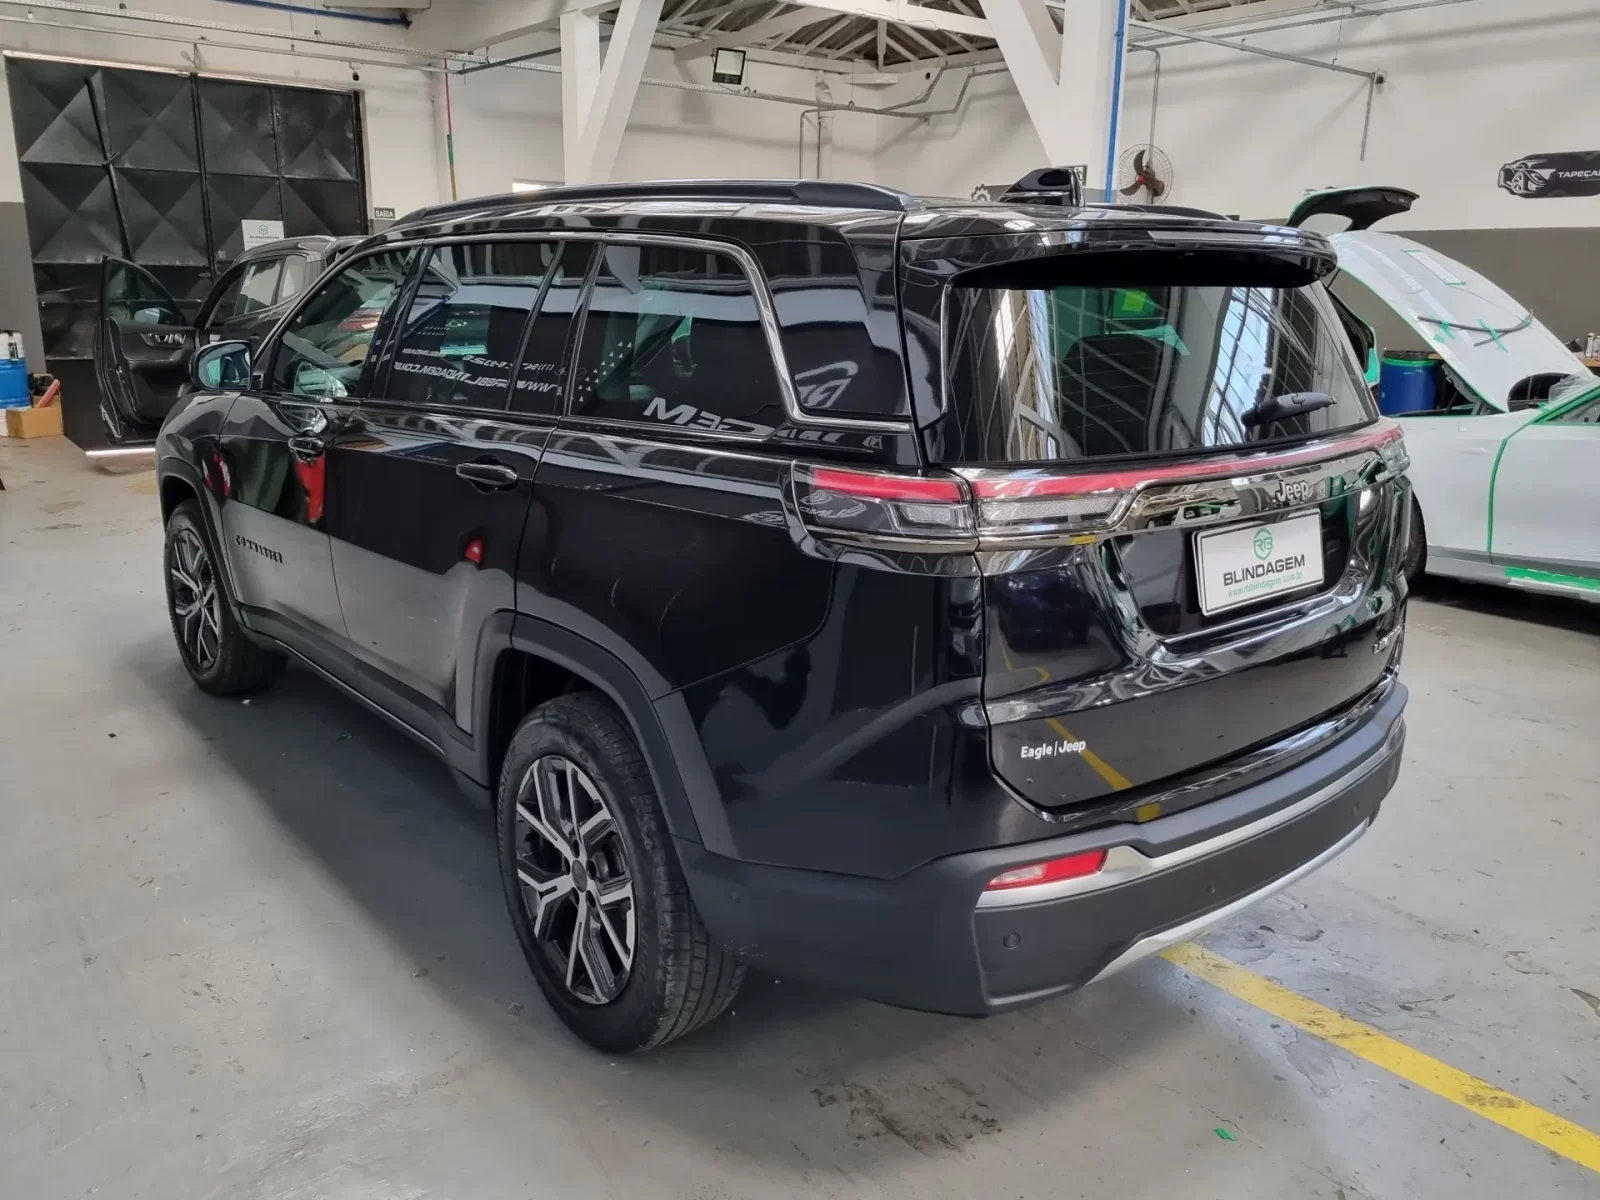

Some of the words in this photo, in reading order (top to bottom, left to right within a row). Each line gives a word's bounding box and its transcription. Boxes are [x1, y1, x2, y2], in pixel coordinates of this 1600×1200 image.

[375, 209, 394, 218] SAÍDA
[1275, 480, 1308, 503] Jeep
[1223, 554, 1306, 587] BLINDAGEM
[1227, 571, 1303, 597] www.rbblindagem.com.br
[1020, 743, 1053, 759] Eagle
[1058, 740, 1086, 753] Jeep
